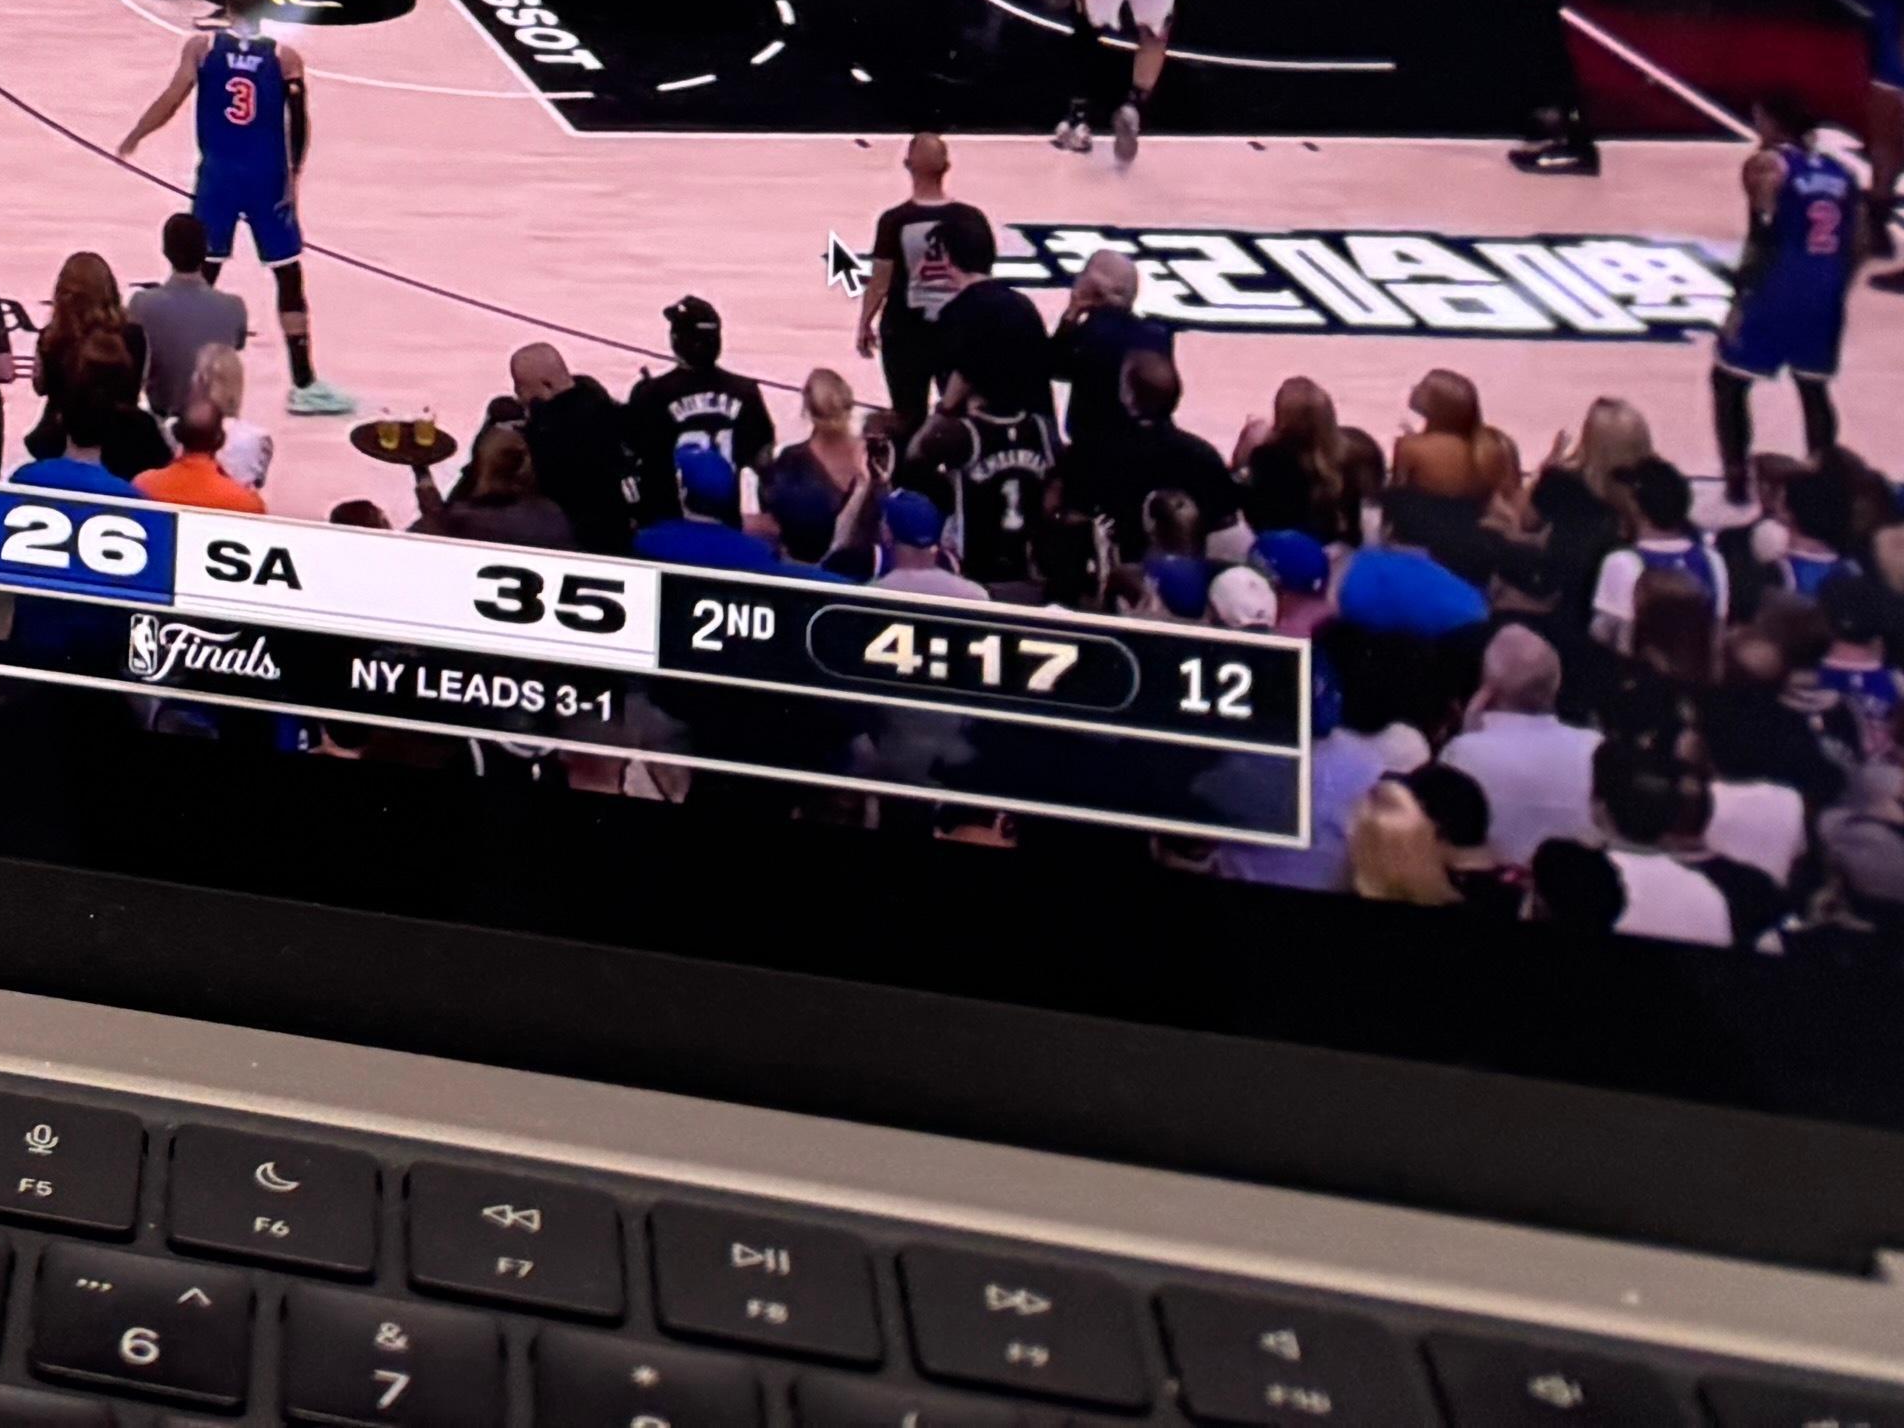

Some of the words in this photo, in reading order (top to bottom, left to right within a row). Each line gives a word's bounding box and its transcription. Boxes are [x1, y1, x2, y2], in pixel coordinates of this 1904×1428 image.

[223, 76, 258, 126] 3
[0, 505, 149, 577] 26
[204, 540, 303, 591] SA
[473, 564, 627, 634] 35
[153, 622, 282, 681] Finals
[692, 598, 776, 651] 2ND
[864, 624, 1080, 691] 4:17
[1178, 658, 1253, 718] 12
[351, 658, 405, 693] NY
[416, 666, 545, 712] LEADS
[555, 684, 612, 722] 3-1
[18, 1177, 54, 1197] F5
[253, 1216, 291, 1237] F6
[496, 1256, 535, 1278] F7
[120, 1327, 160, 1364] 6
[375, 1322, 409, 1350] &
[374, 1369, 410, 1408] 7
